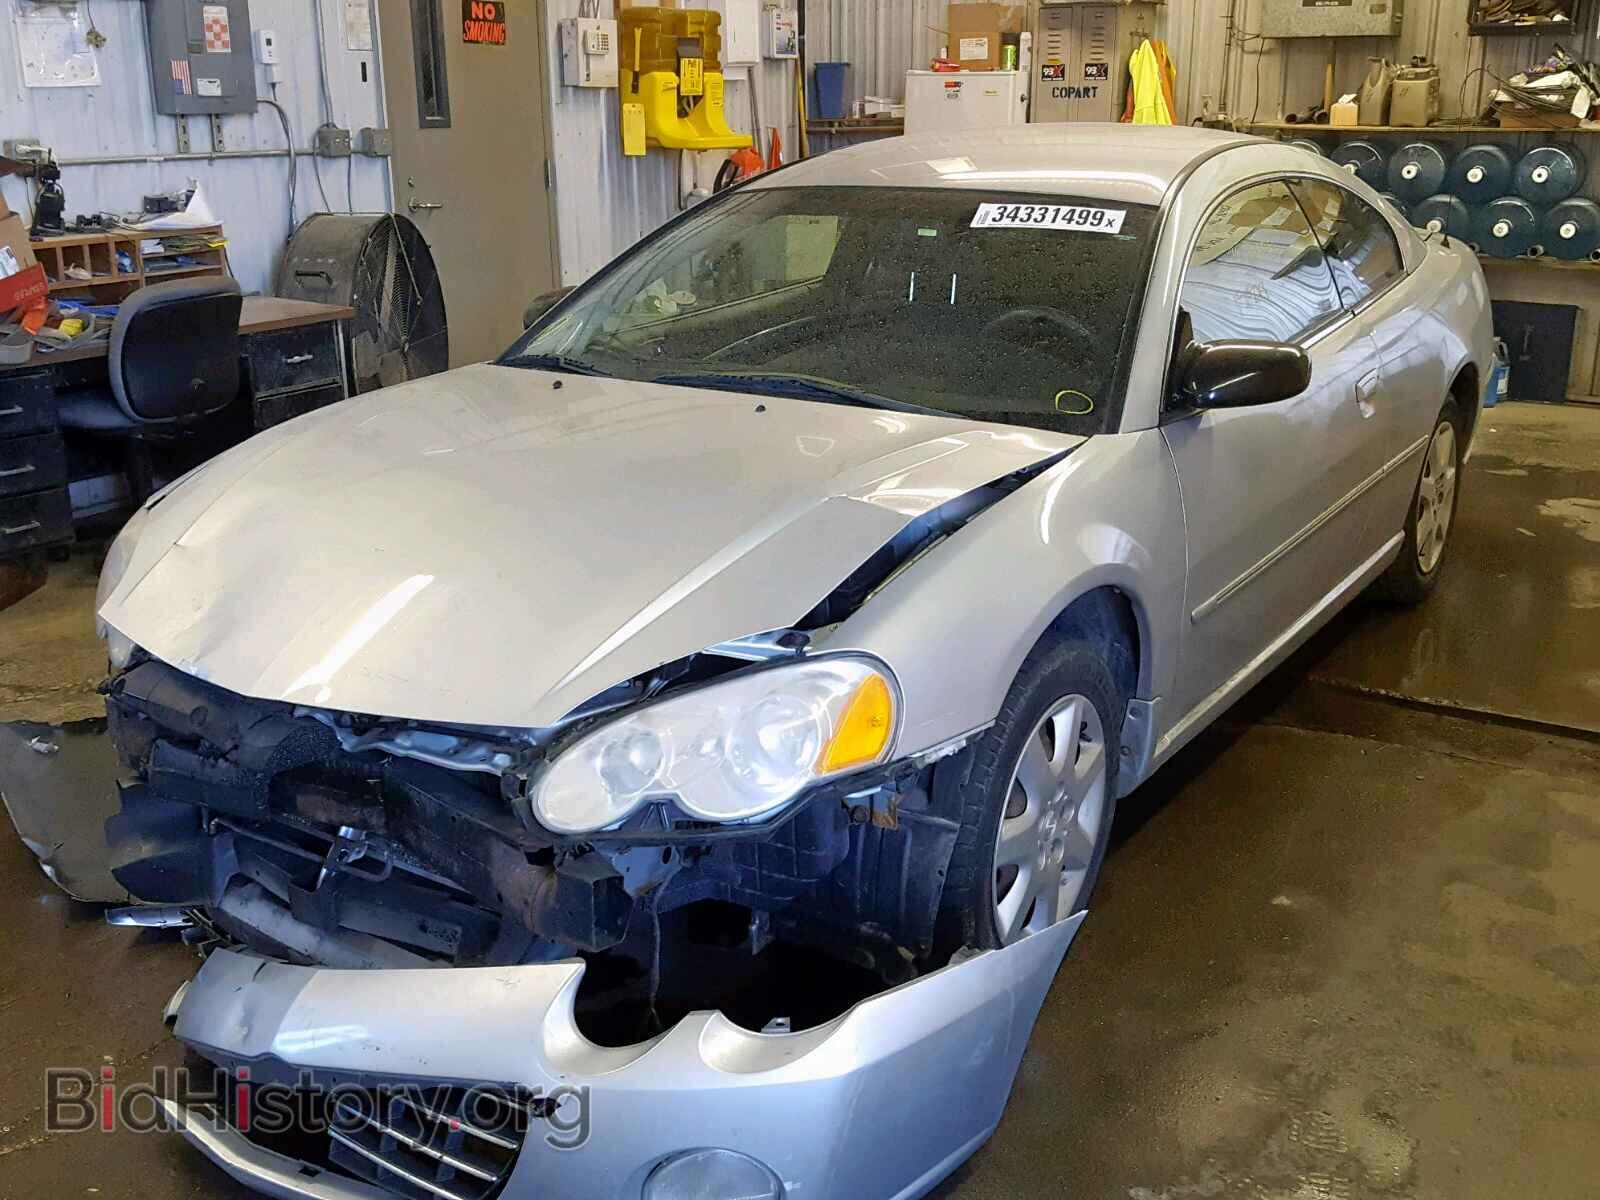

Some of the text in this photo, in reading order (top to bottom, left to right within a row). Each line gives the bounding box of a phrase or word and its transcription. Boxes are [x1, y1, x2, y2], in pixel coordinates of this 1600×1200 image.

[471, 1, 496, 20] NO
[463, 20, 505, 43] SMOKING
[1052, 86, 1098, 98] COPART
